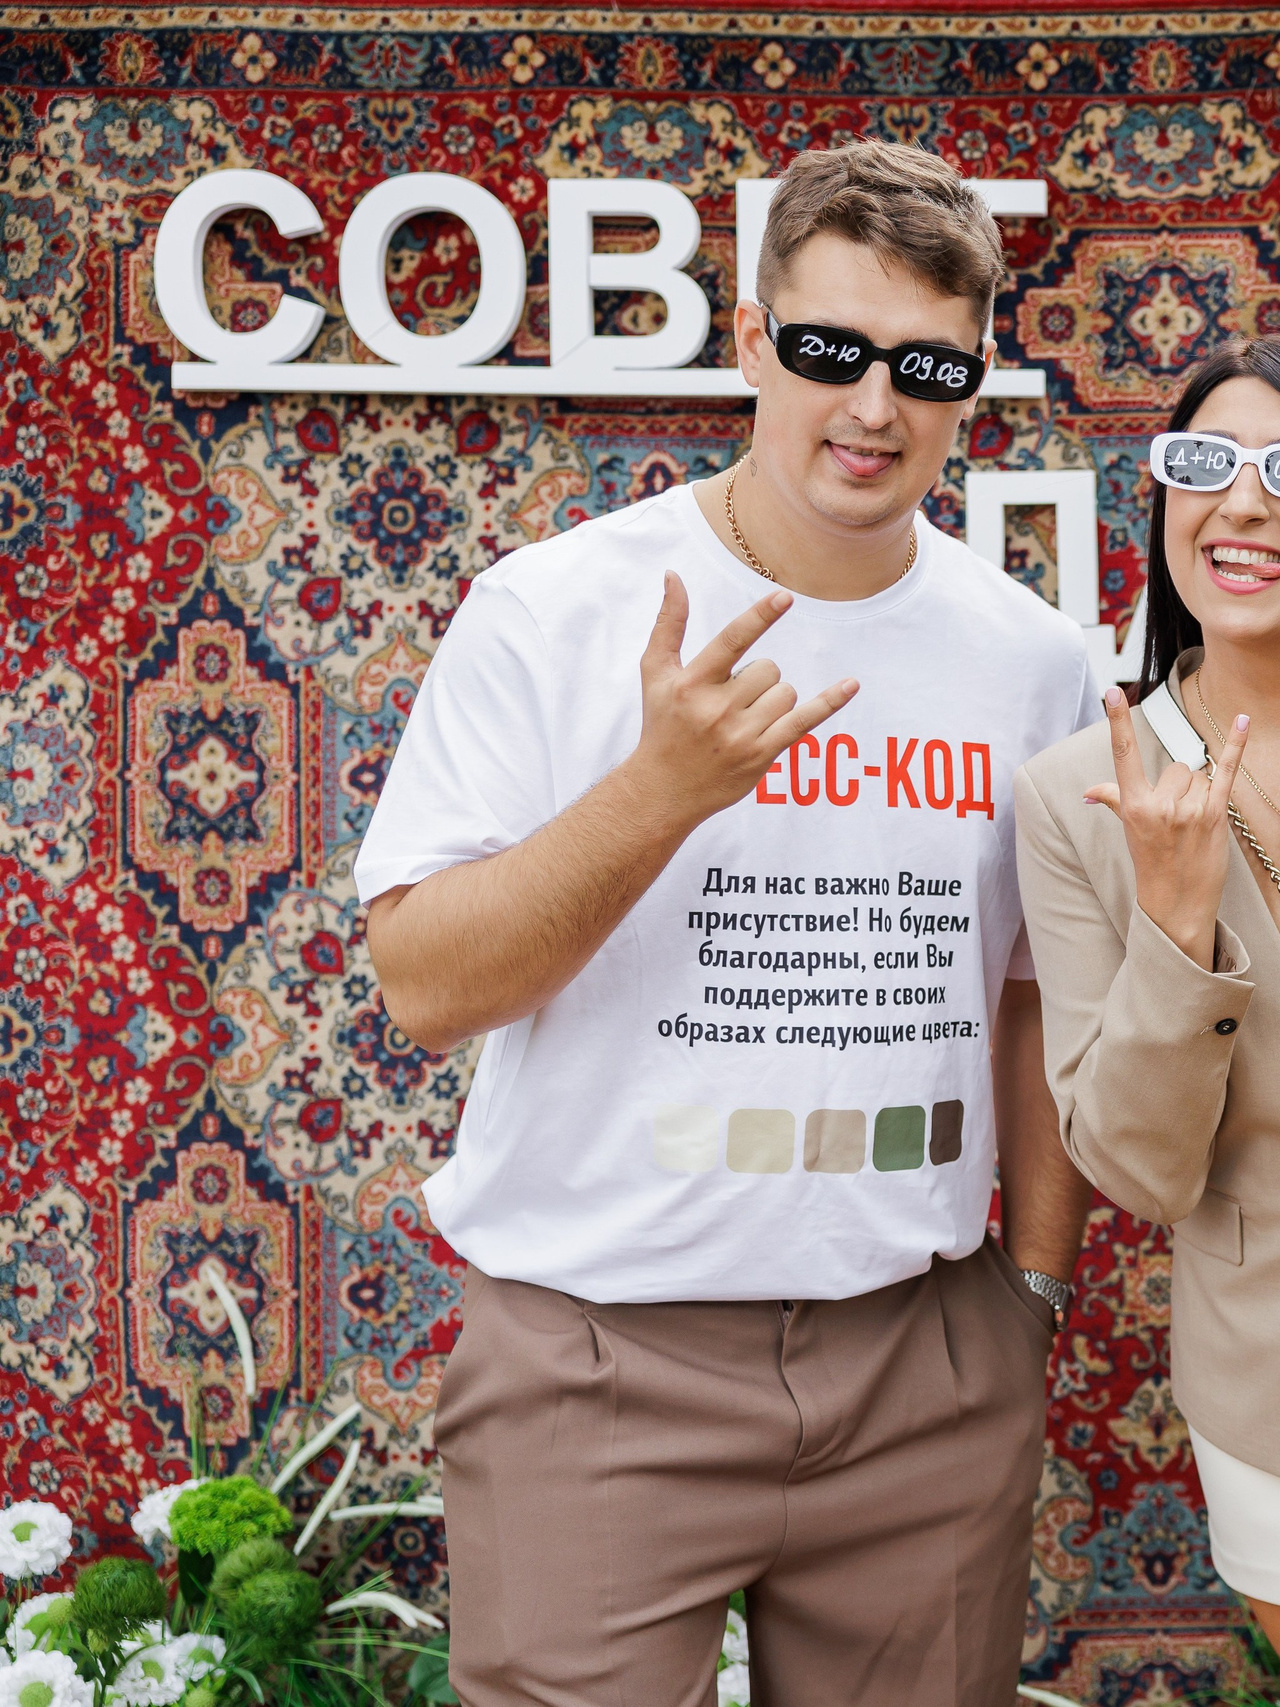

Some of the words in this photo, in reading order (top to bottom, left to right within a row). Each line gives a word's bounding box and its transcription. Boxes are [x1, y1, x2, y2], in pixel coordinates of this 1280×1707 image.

[154, 168, 1048, 372] СОВ
[899, 352, 969, 388] 09.08
[1167, 447, 1228, 471] Д+Ю
[756, 733, 995, 821] ЕСС-КОД
[702, 867, 757, 897] Для
[765, 876, 806, 895] нас
[814, 877, 890, 896] важно
[897, 871, 962, 897] Ваше
[688, 906, 859, 939] присутствие!
[869, 907, 892, 933] Но
[899, 906, 970, 939] будем
[698, 939, 866, 977] благодарны,
[873, 951, 919, 970] если
[926, 943, 954, 968] Вы
[704, 986, 868, 1014] поддержите
[876, 988, 887, 1006] в
[893, 986, 946, 1006] своих
[657, 1013, 766, 1048] образах
[775, 1024, 916, 1051] следующие
[922, 1020, 979, 1044] цвета:
